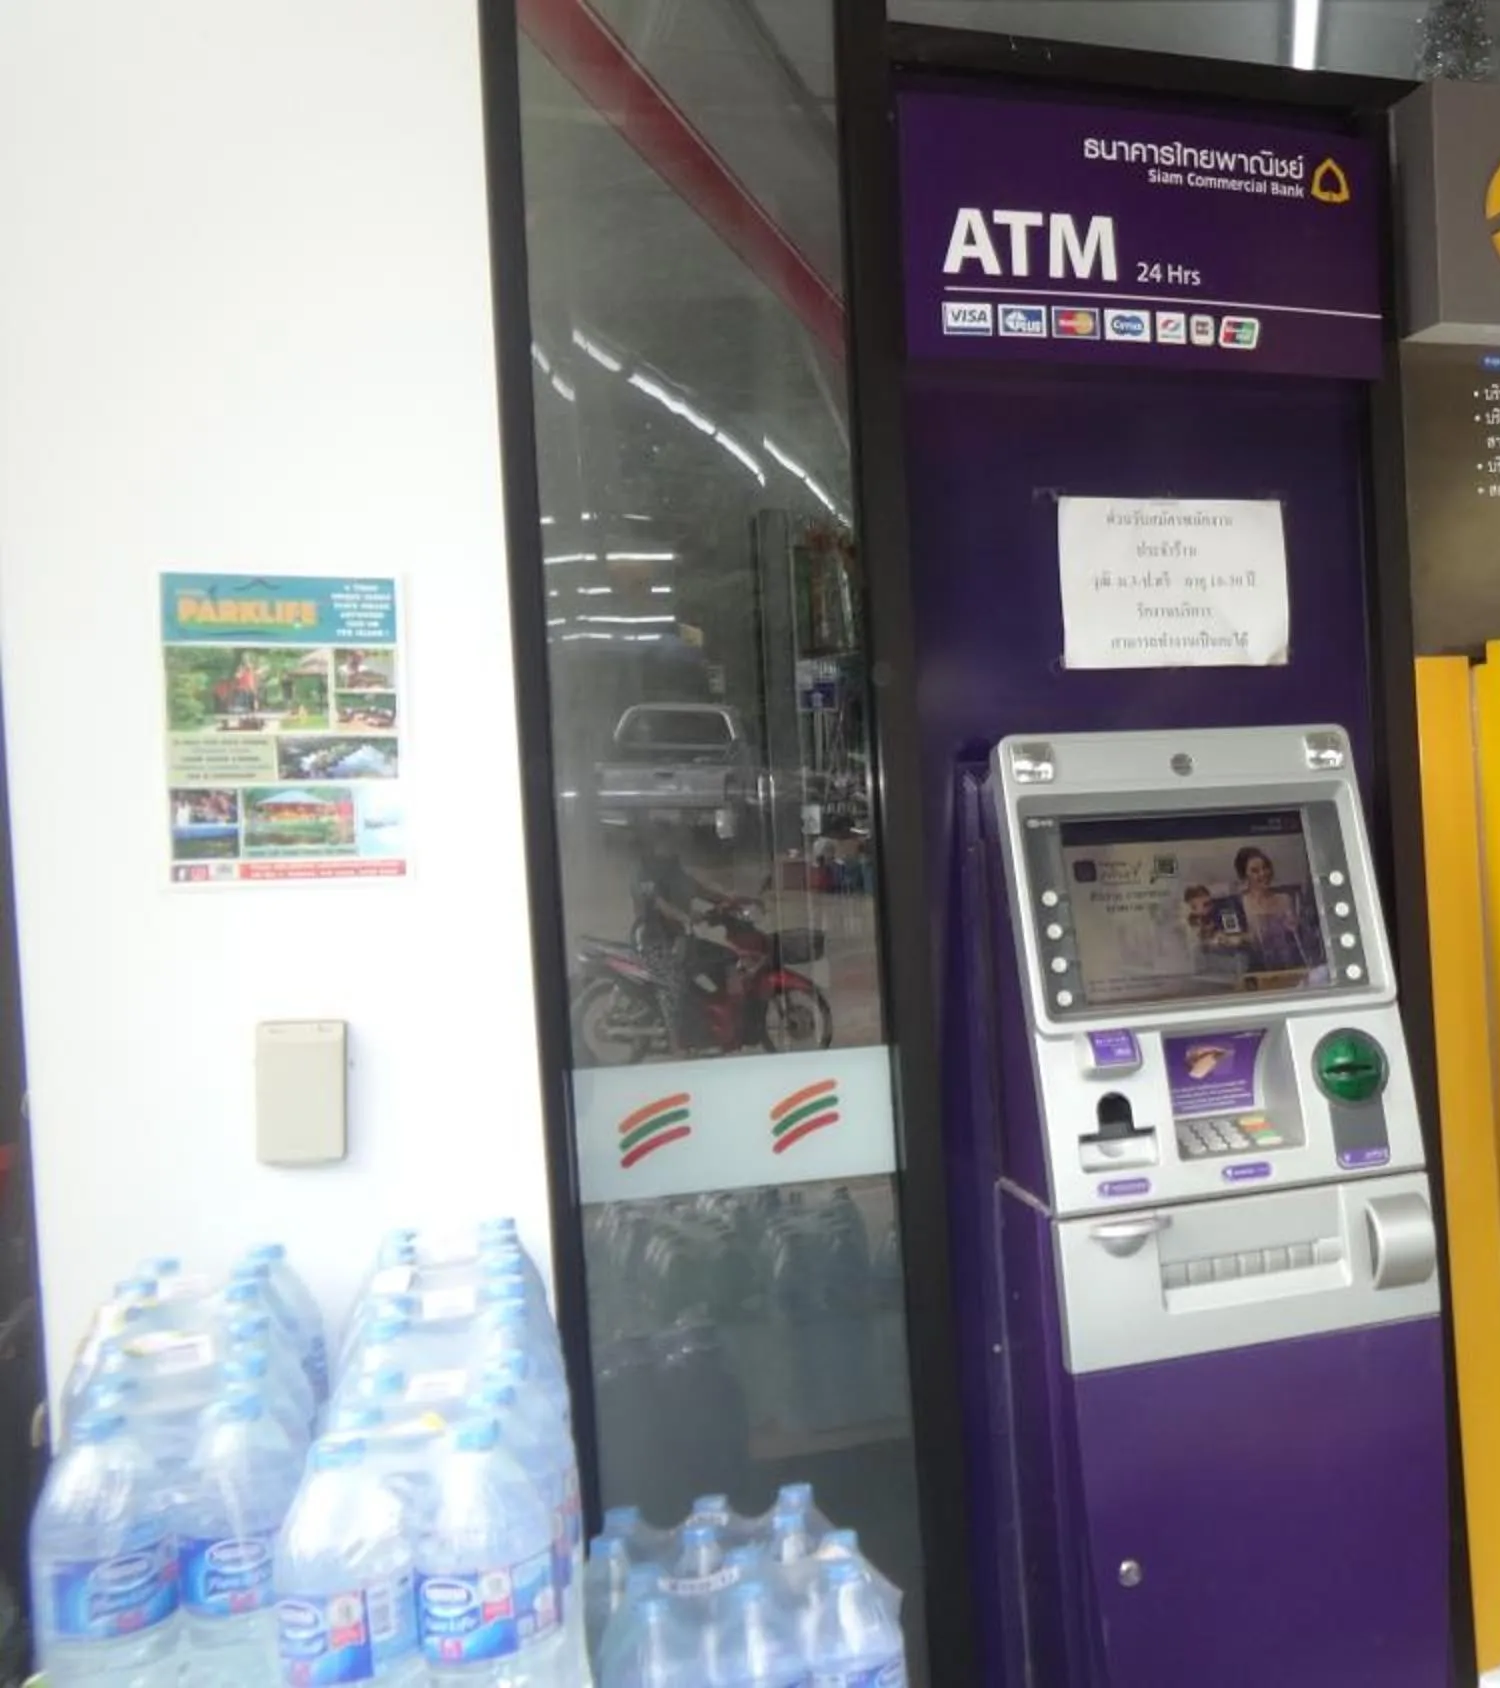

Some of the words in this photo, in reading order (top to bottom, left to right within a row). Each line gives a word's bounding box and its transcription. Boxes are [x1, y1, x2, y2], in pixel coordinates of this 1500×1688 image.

[1083, 137, 1304, 180] ธนาคารไทยพาณิชย์
[1148, 167, 1183, 187] Siam
[1187, 173, 1267, 196] Commercial
[1271, 181, 1304, 198] Bank
[942, 207, 1118, 281] ATM
[1136, 262, 1162, 284] 24
[1167, 265, 1201, 287] Hrs
[950, 308, 988, 323] VISA
[178, 595, 318, 626] PARKLIFE
